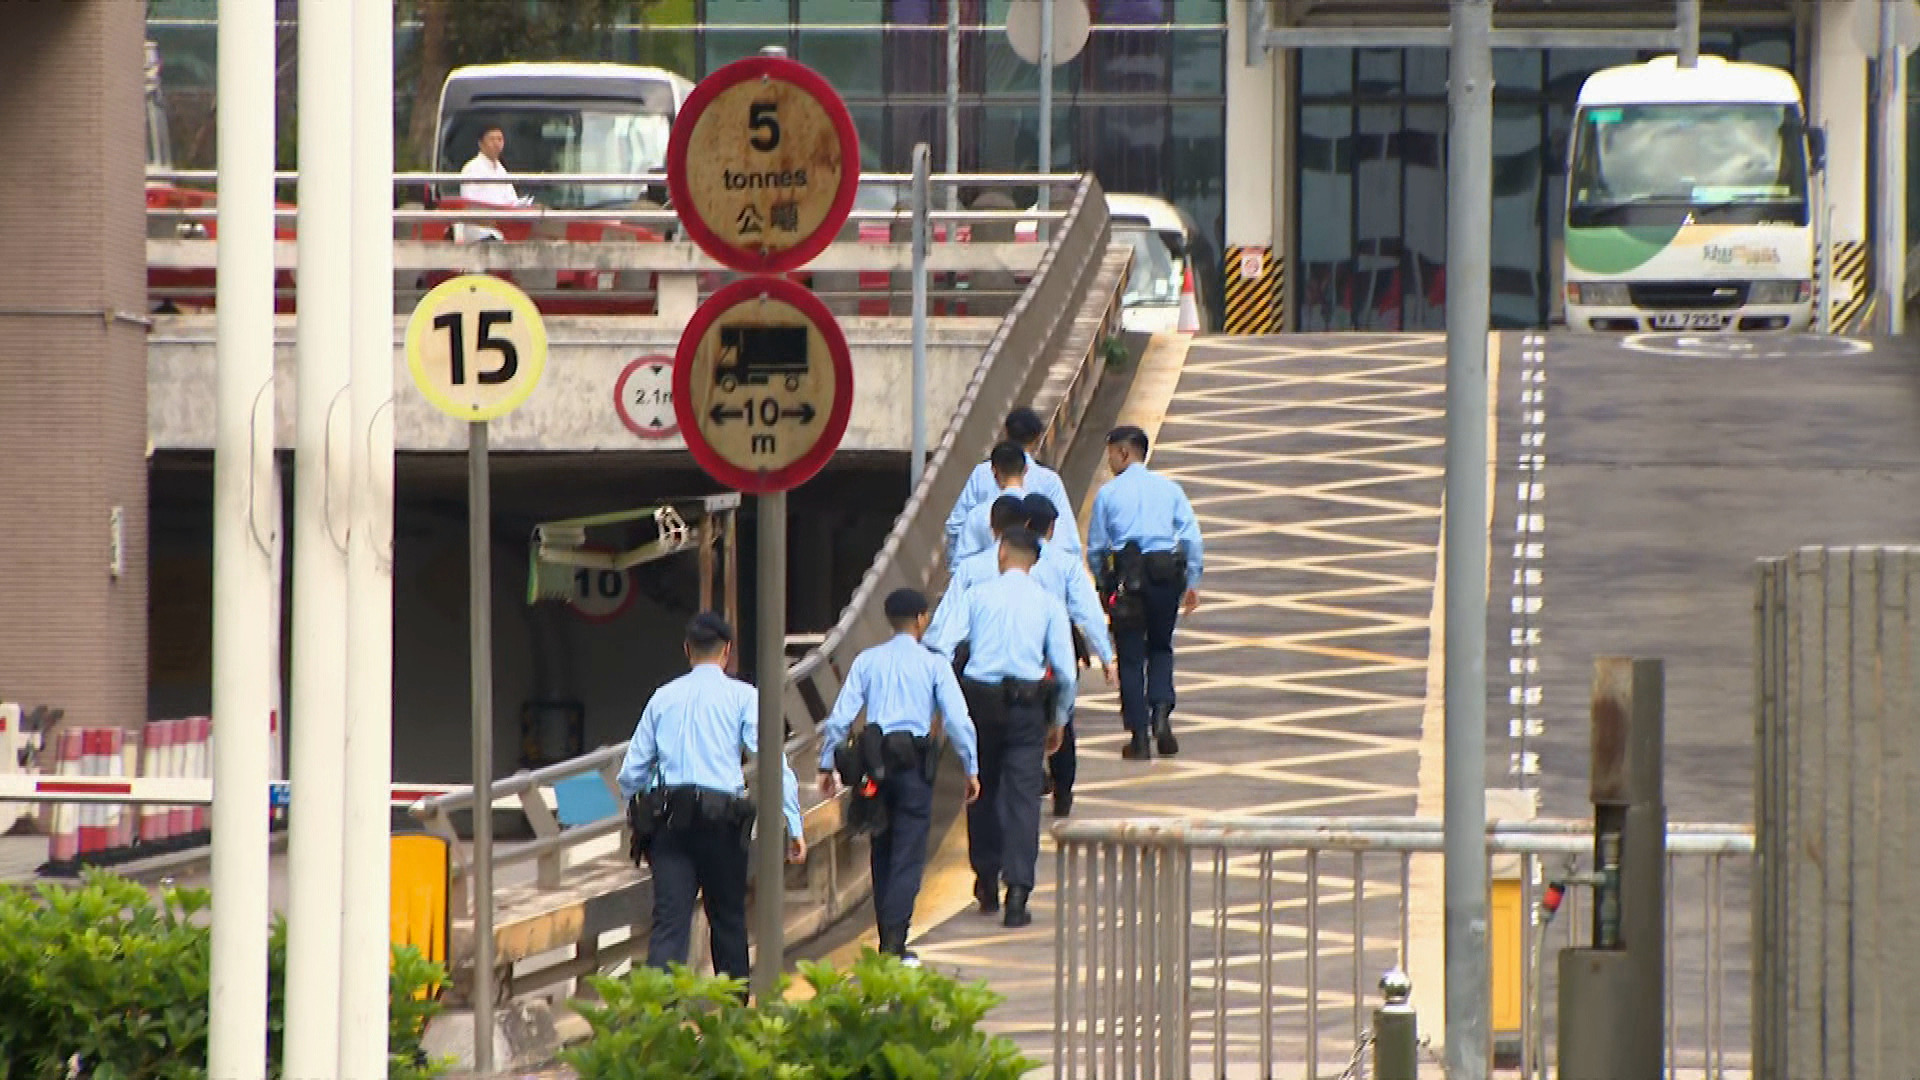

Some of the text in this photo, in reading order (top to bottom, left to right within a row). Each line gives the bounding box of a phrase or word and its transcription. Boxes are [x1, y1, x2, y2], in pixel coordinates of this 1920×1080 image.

[749, 103, 780, 152] 5
[724, 168, 807, 190] tonnes
[433, 311, 518, 385] 15
[744, 397, 779, 427] 10
[751, 434, 776, 455] m
[575, 568, 622, 598] 10
